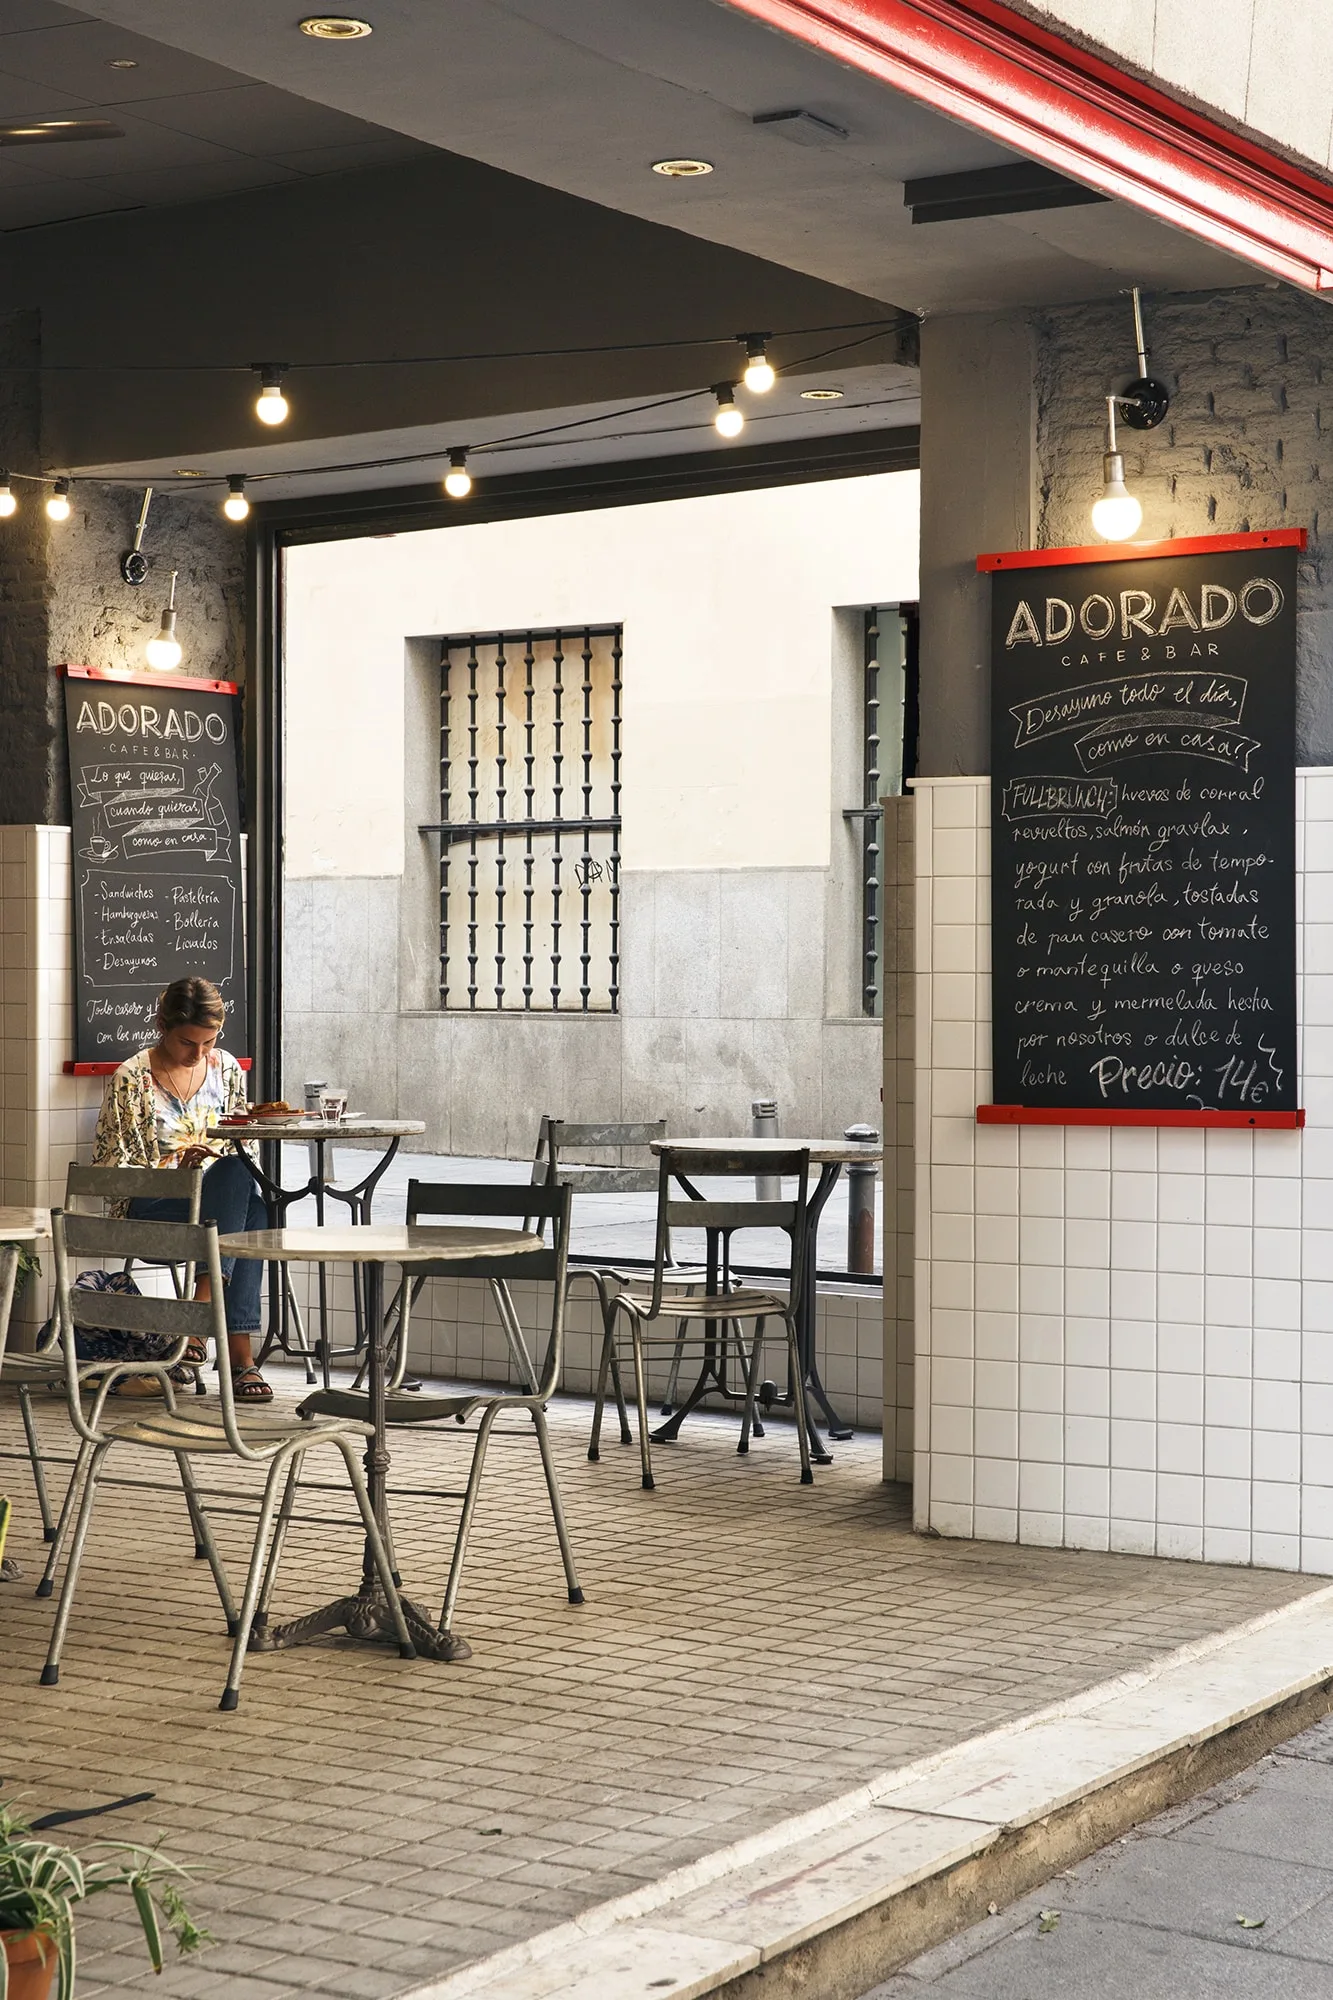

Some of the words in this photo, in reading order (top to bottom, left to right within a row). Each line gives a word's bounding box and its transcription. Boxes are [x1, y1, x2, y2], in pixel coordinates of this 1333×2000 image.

[1005, 577, 1285, 649] ADORADO
[1061, 650, 1126, 667] CAFE
[1166, 643, 1219, 659] BAR
[1026, 692, 1112, 735] Desayuno
[1119, 681, 1165, 706] todo
[1173, 680, 1192, 704] el
[1200, 678, 1237, 707] día,
[76, 701, 228, 745] ADORADO
[109, 743, 149, 757] CAFE
[165, 748, 189, 760] BAR
[1088, 733, 1139, 760] como
[1145, 733, 1170, 746] en
[91, 766, 108, 783] Lo
[114, 770, 132, 788] que
[1122, 783, 1170, 801] huevos
[1176, 778, 1191, 801] de
[1200, 776, 1265, 801] corral
[111, 801, 154, 817] cuando
[1012, 818, 1094, 841] revueltos,
[1095, 815, 1151, 838] salmón
[132, 835, 163, 847] como
[165, 836, 178, 846] en
[1015, 852, 1080, 890] yogurt
[1087, 861, 1111, 876] con
[1118, 852, 1173, 885] frutas
[1181, 847, 1202, 871] de
[101, 881, 154, 900] Sandwiches
[171, 886, 220, 905] Pastelería
[1016, 890, 1059, 912] rada
[1069, 897, 1084, 922] y
[1183, 880, 1259, 905] tostadas
[101, 906, 159, 928] Hamburguesas
[173, 909, 219, 930] Bollería
[101, 928, 154, 946] Ensaladas
[175, 932, 218, 951] Licuados
[1017, 922, 1037, 945] de
[1047, 931, 1085, 955] pan
[1091, 927, 1153, 943] casero
[1162, 926, 1193, 941] con
[1199, 914, 1270, 940] tomate
[103, 952, 158, 974] Desayunos
[1017, 966, 1030, 978] o
[1036, 952, 1160, 989] mantequilla
[1171, 962, 1184, 975] o
[1191, 962, 1244, 988] queso
[86, 998, 113, 1023] Todo
[143, 1003, 158, 1022] y
[1014, 999, 1078, 1013] crema
[1086, 999, 1107, 1021] y
[1114, 989, 1218, 1011] mermelada
[96, 1031, 113, 1044] con
[116, 1025, 129, 1041] los
[1017, 1031, 1049, 1060] por
[1057, 1023, 1132, 1047] nosotros
[1144, 1033, 1158, 1046] o
[1165, 1017, 1220, 1047] dulce
[1225, 1020, 1243, 1046] de
[1020, 1059, 1067, 1087] leche
[1089, 1055, 1203, 1098] Precio:
